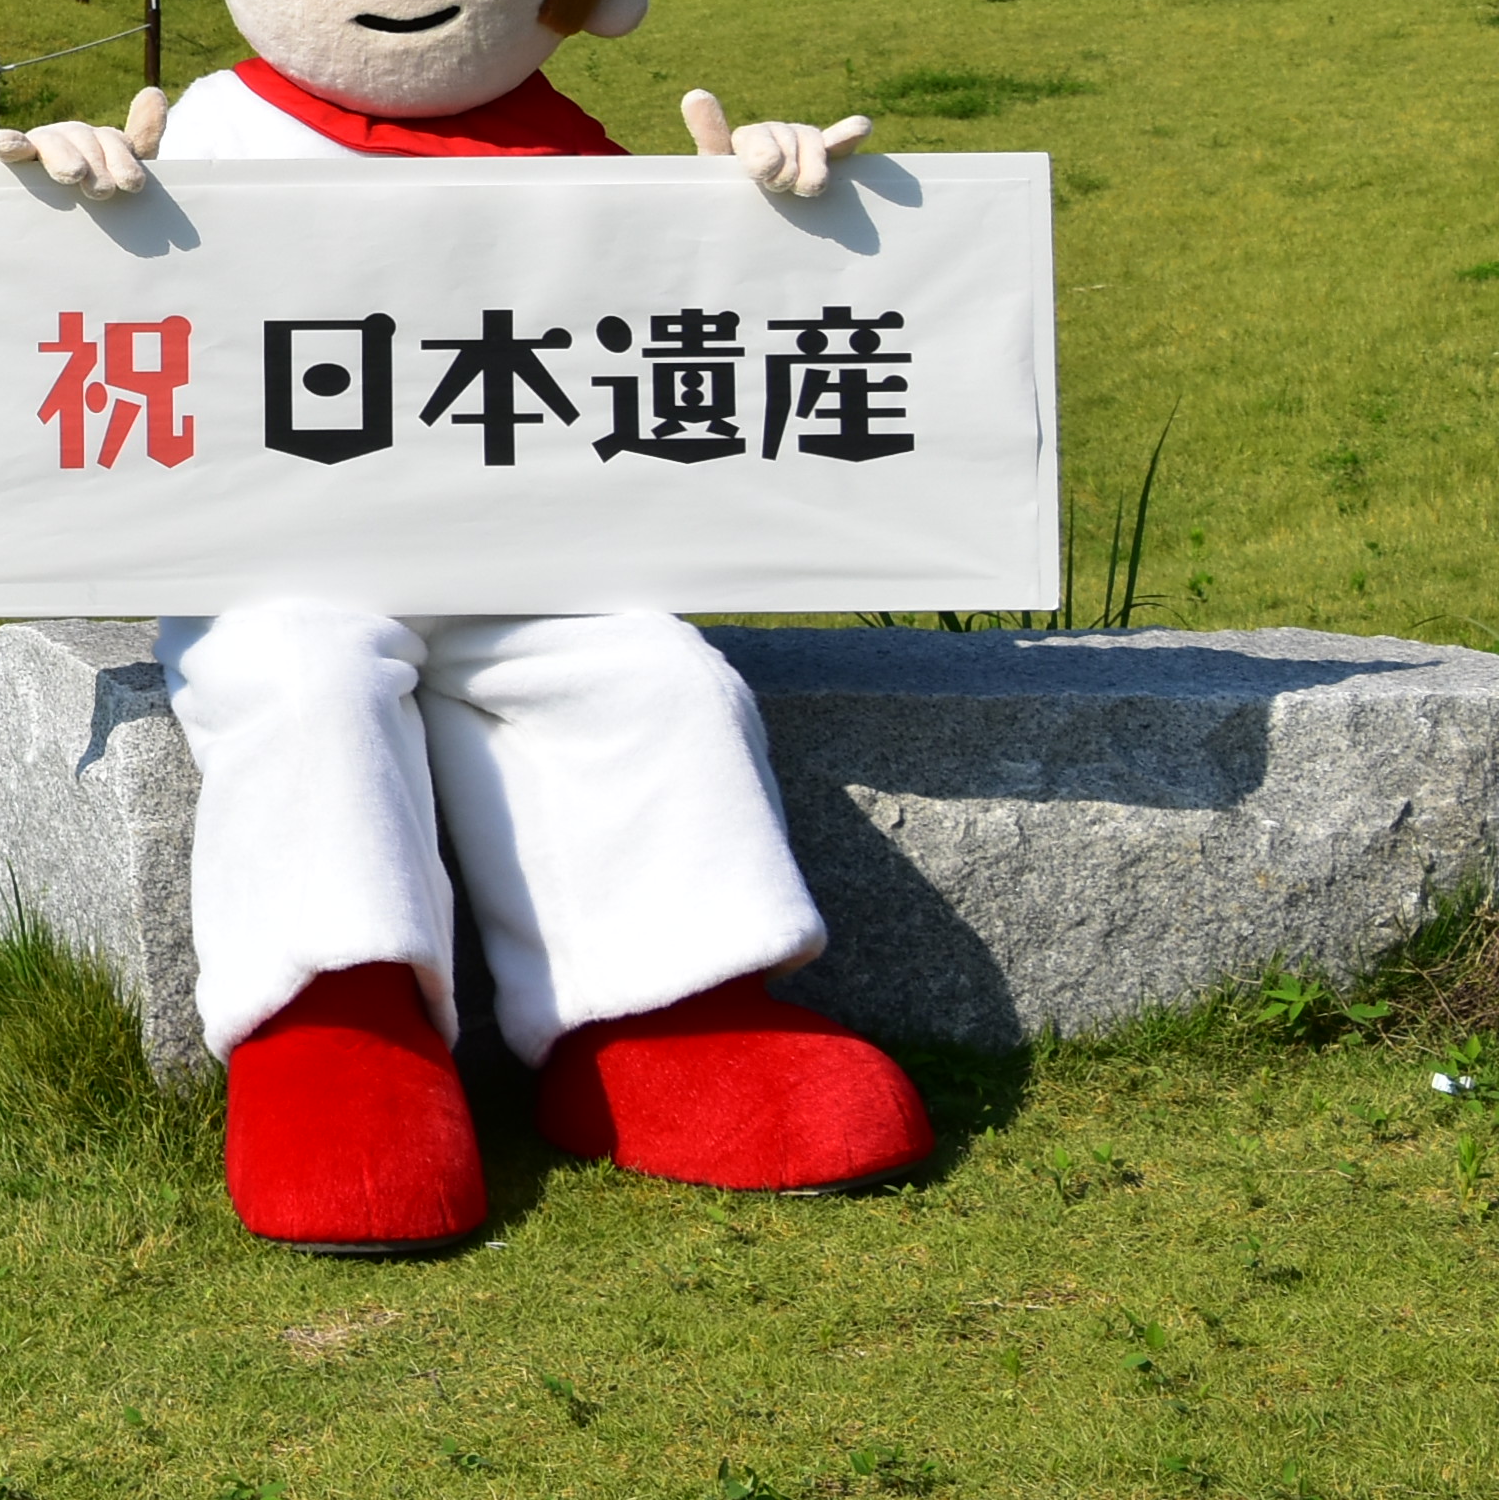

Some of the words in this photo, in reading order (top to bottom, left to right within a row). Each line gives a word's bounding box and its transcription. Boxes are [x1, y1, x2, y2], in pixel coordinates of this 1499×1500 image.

[38, 311, 195, 469] 祝
[263, 306, 915, 466] 日本遺産
